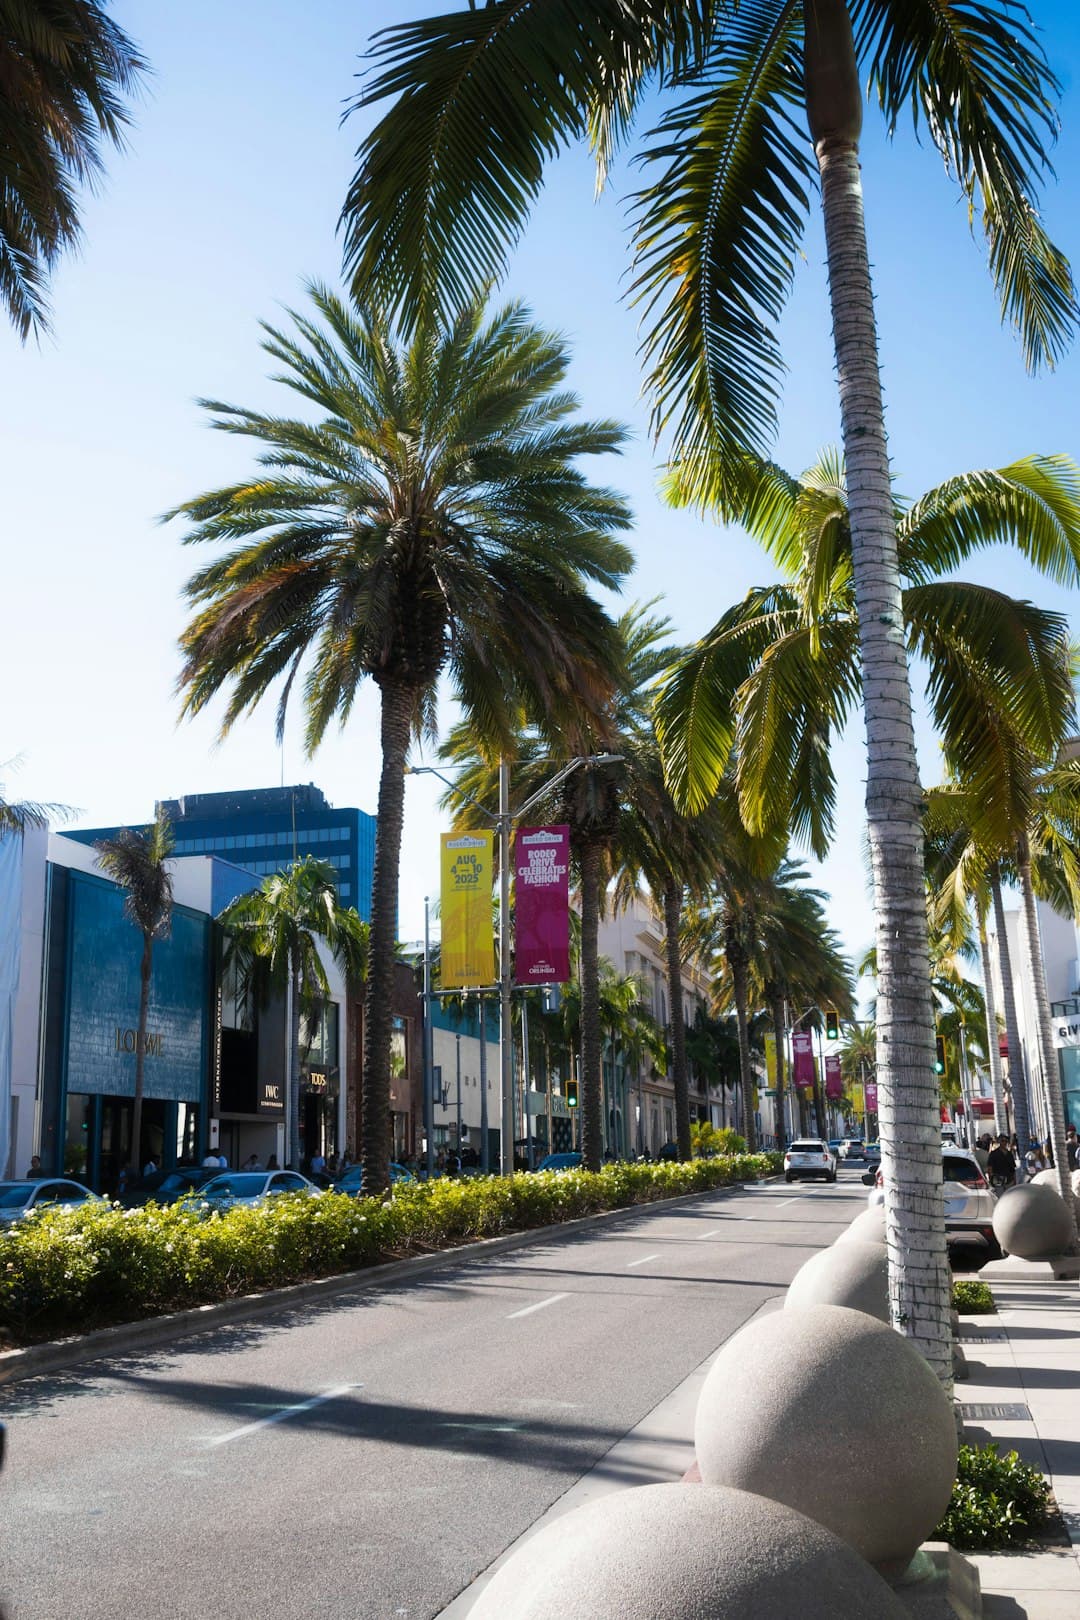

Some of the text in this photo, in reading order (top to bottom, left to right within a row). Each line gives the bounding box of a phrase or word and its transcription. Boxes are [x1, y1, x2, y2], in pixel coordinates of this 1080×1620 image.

[528, 849, 557, 859] RODEO
[457, 855, 476, 865] AUG
[530, 857, 555, 867] DRIVE
[450, 865, 457, 874] 4
[472, 864, 482, 873] 10
[518, 865, 566, 876] CELEBRATES
[455, 873, 479, 884] 2025
[524, 874, 560, 885] FASHION
[1059, 1023, 1080, 1037] GIV
[265, 1084, 279, 1099] IWC
